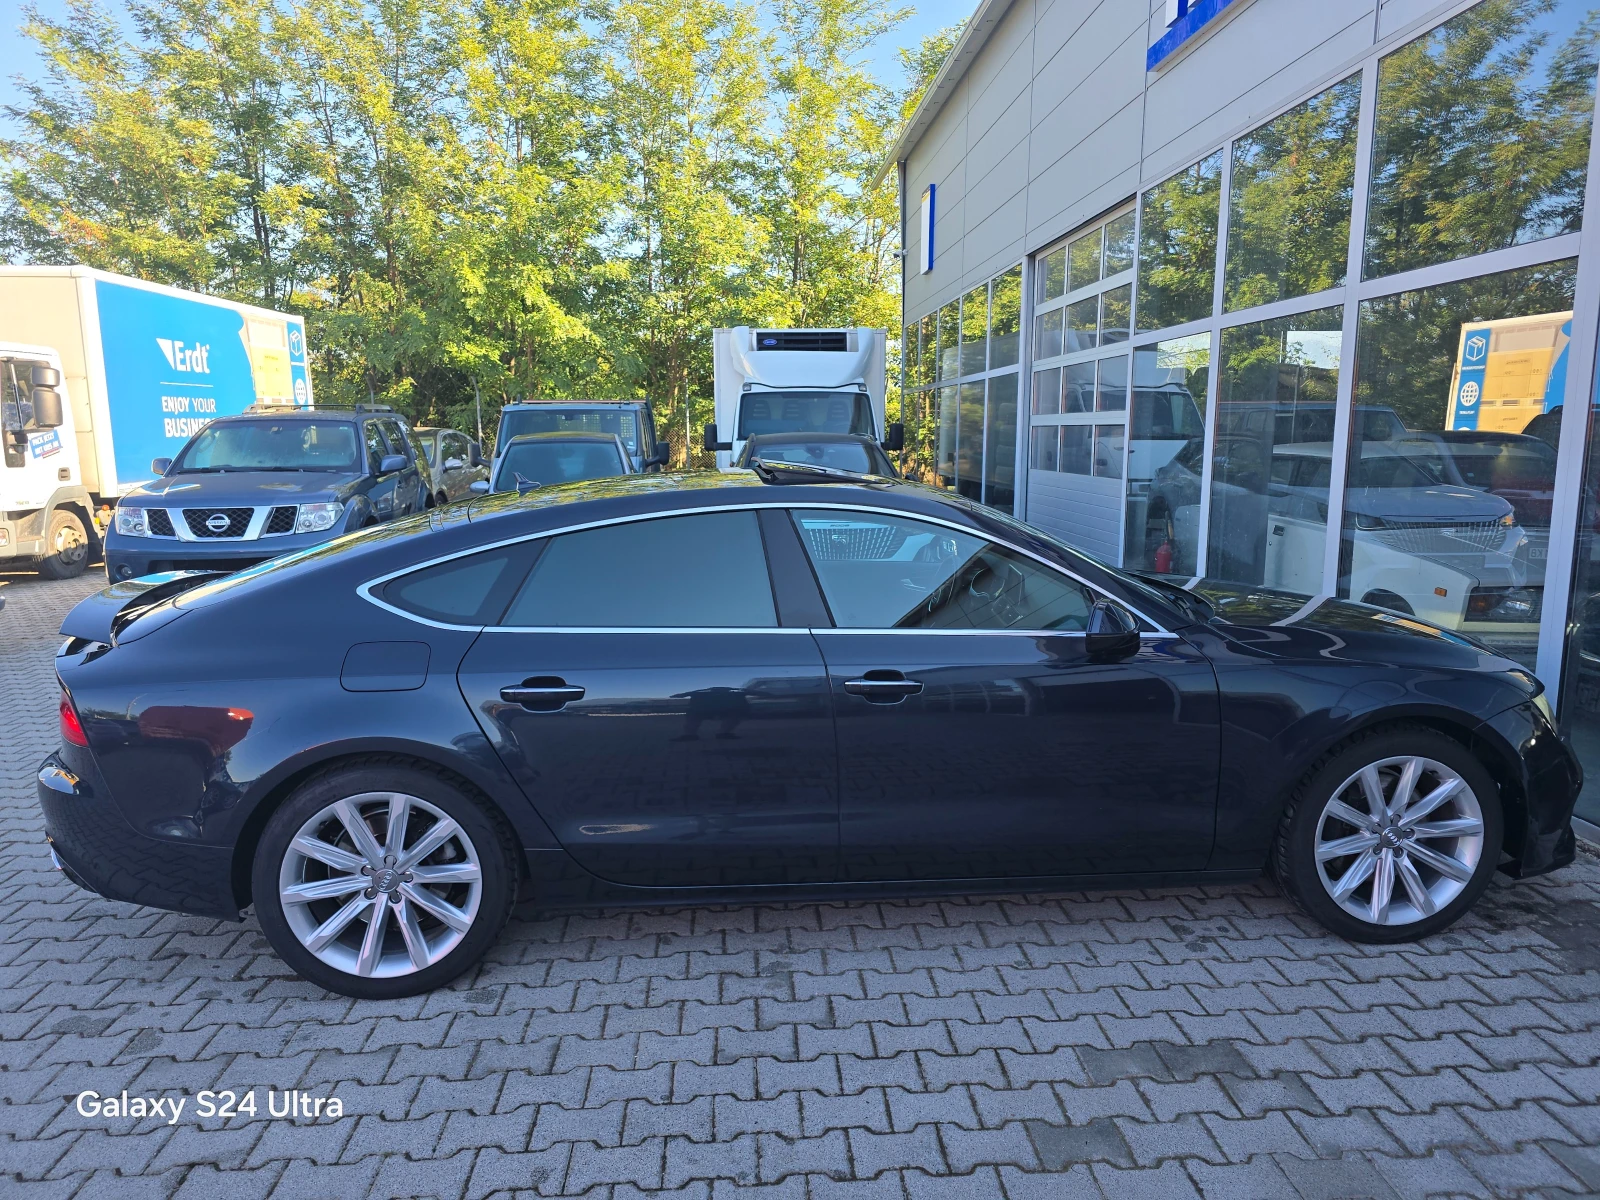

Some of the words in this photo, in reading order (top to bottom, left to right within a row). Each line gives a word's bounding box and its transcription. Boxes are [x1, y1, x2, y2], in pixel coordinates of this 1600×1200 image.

[174, 341, 211, 374] Erdt
[161, 396, 190, 415] ENJOY
[192, 397, 217, 413] YOUR
[164, 418, 215, 438] BUSINE
